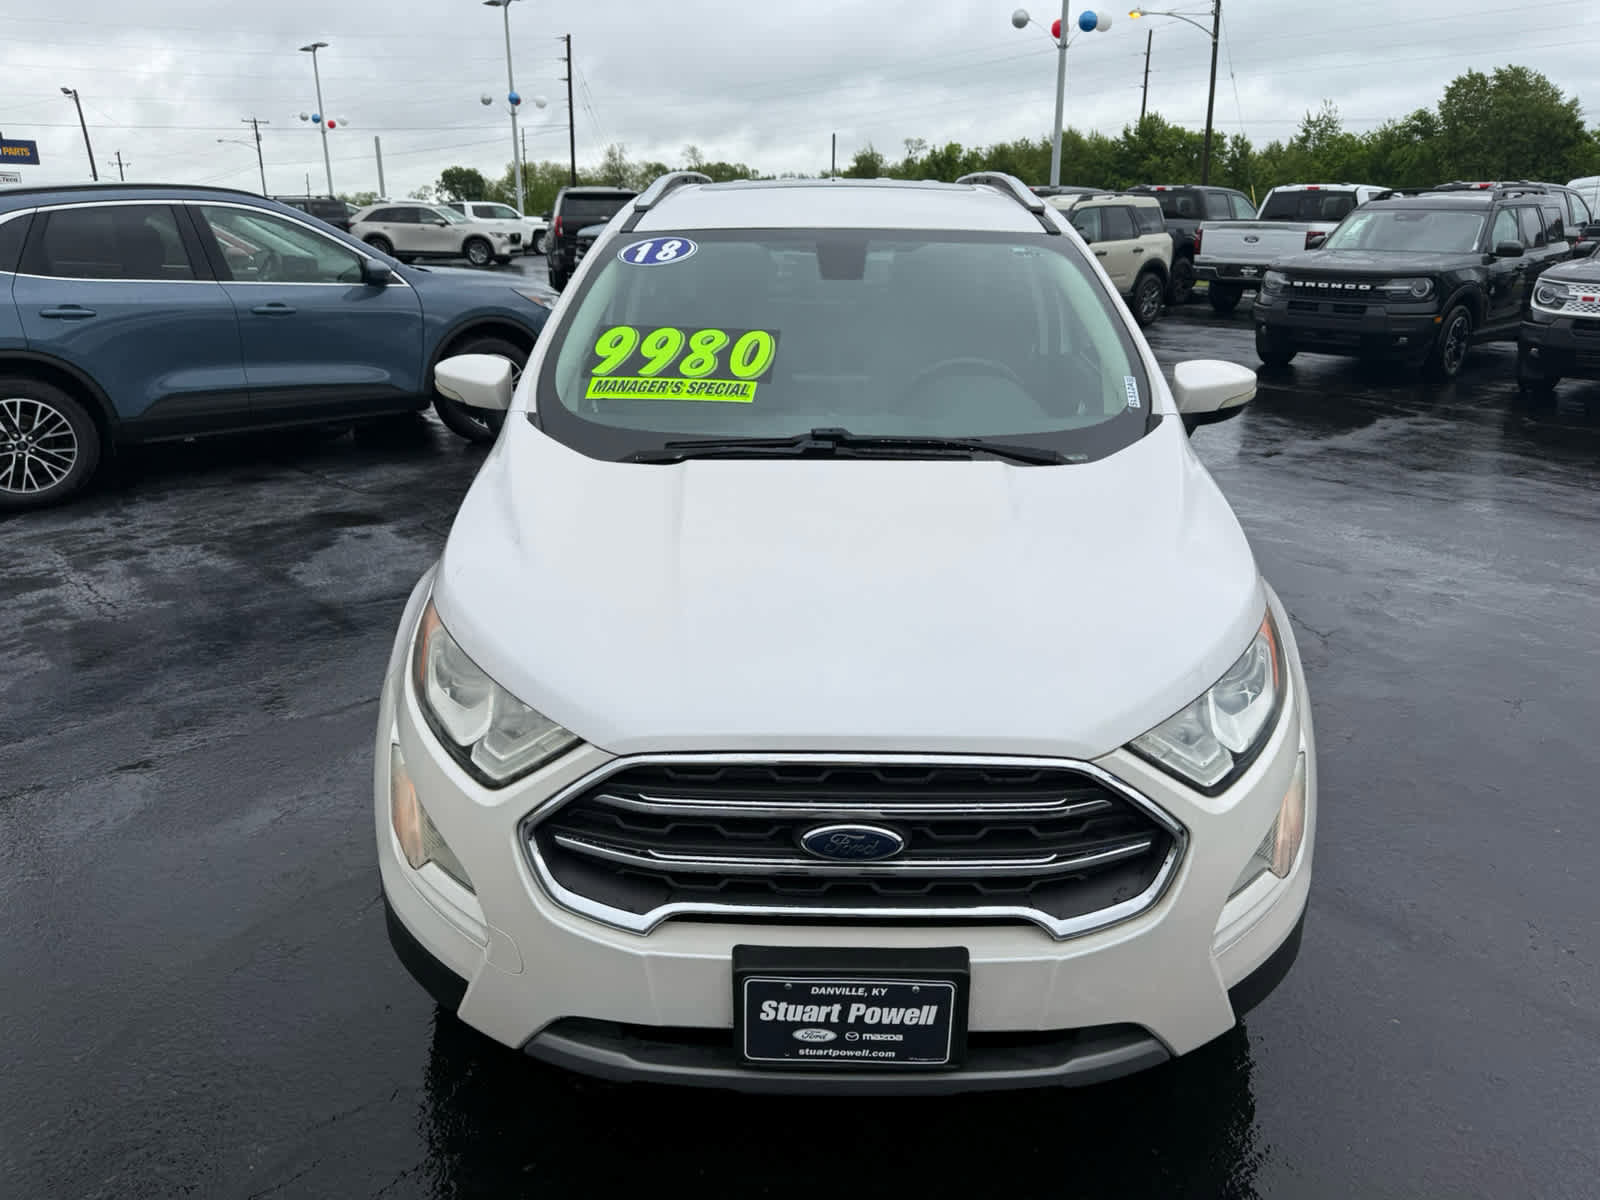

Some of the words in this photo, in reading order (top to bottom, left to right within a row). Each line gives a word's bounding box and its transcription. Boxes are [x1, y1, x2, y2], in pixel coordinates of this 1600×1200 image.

[2, 146, 31, 157] PARTS
[633, 239, 682, 262] 18
[1293, 281, 1371, 290] BRONCO
[591, 326, 775, 379] 9980
[592, 380, 682, 394] MANAGER'S
[686, 382, 750, 397] SPECIAL
[824, 833, 880, 855] Ford
[811, 986, 868, 997] DANVILLE,
[871, 987, 888, 997] KY
[759, 1000, 842, 1023] Stuart
[847, 1003, 938, 1026] Powell
[798, 1048, 896, 1058] stuartpowell.com
